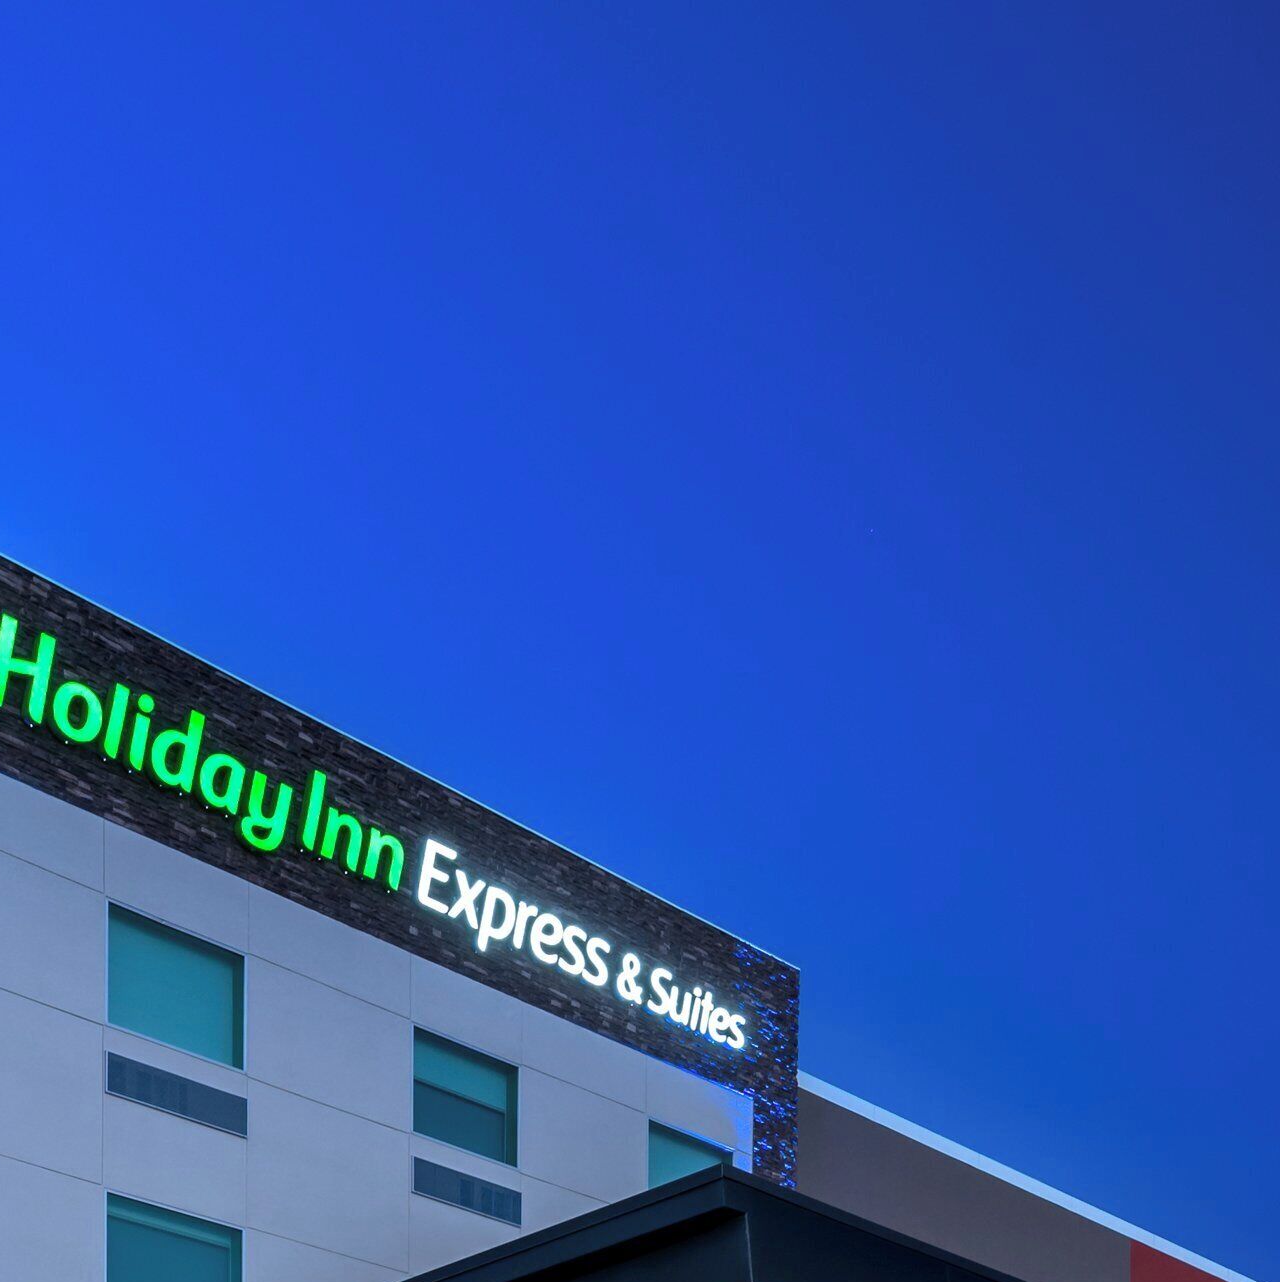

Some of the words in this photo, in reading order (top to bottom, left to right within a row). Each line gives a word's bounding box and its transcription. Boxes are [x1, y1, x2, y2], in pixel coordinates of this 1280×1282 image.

[301, 769, 404, 892] Inn
[415, 837, 611, 987] Express
[615, 951, 643, 1005] &
[647, 966, 747, 1050] Suites
